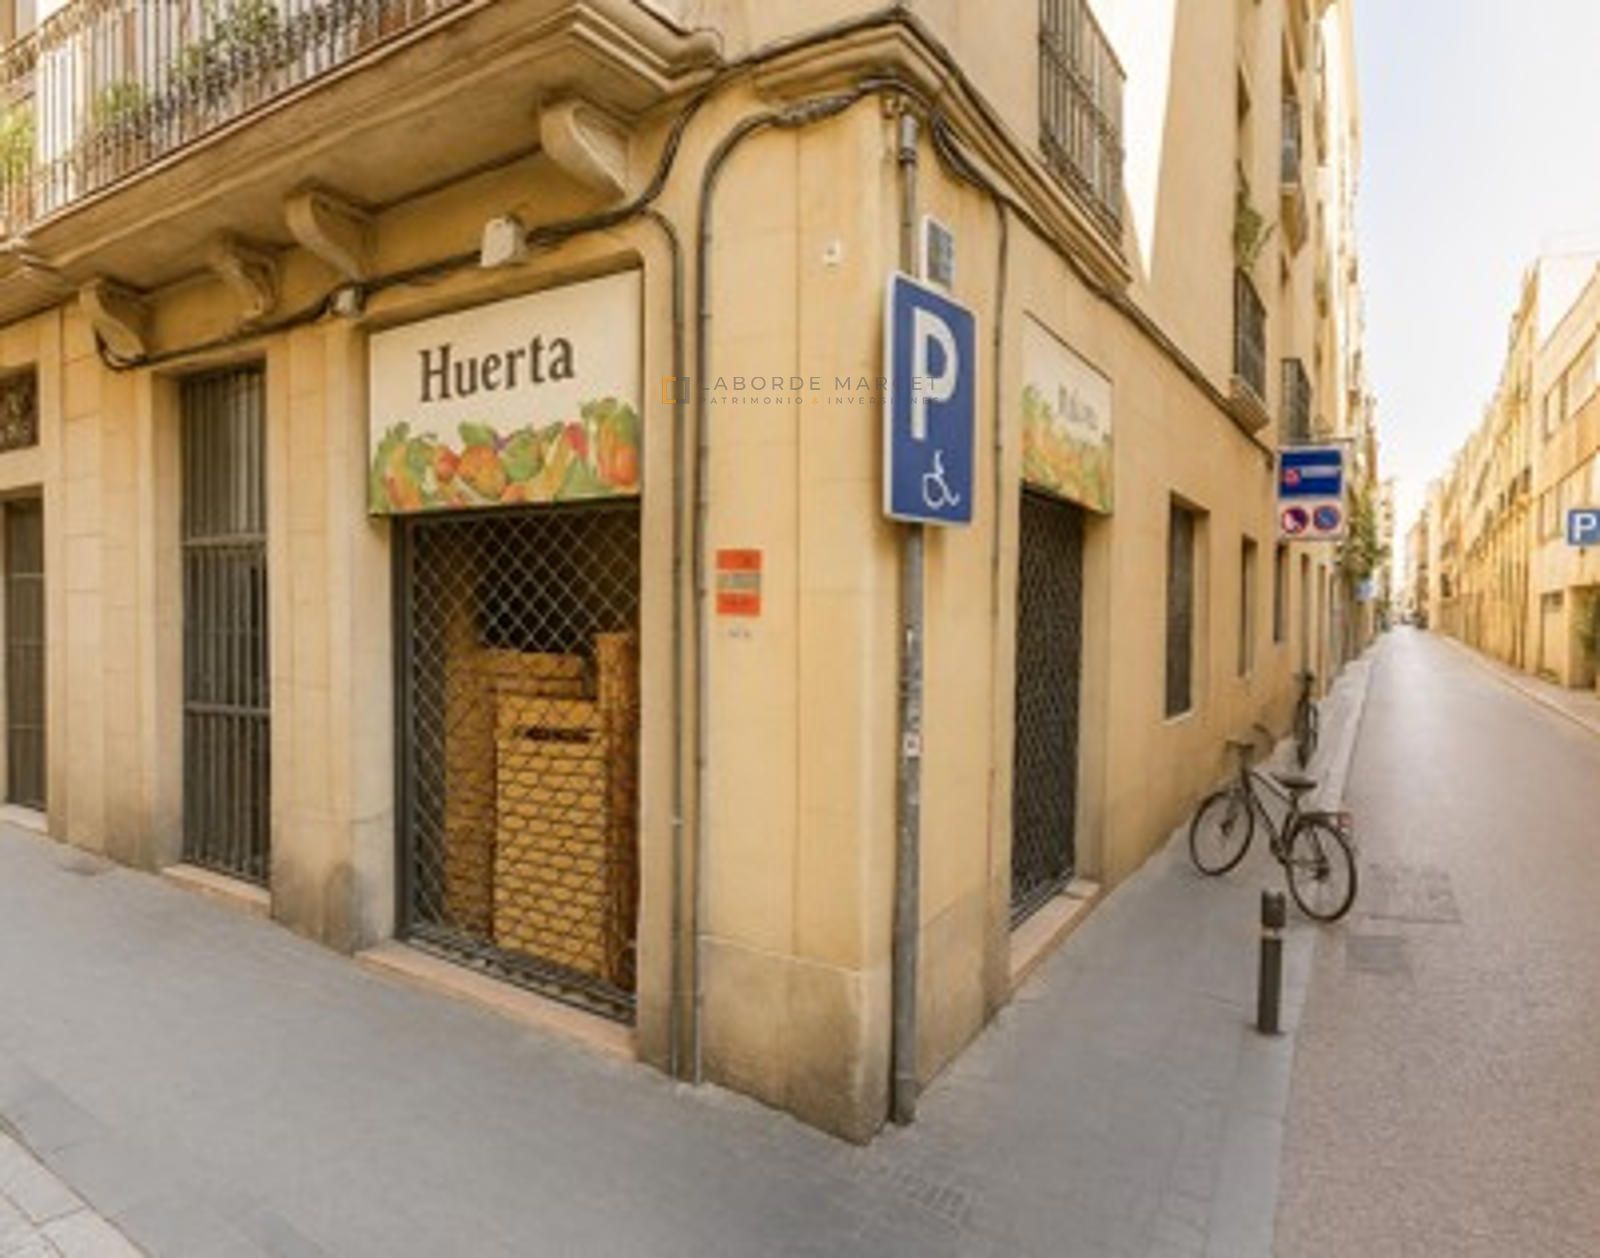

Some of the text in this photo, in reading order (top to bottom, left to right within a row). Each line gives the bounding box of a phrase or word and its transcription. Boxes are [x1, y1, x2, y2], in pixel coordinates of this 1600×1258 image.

[418, 333, 575, 403] Huerta
[911, 306, 959, 440] P
[1574, 512, 1597, 541] P
